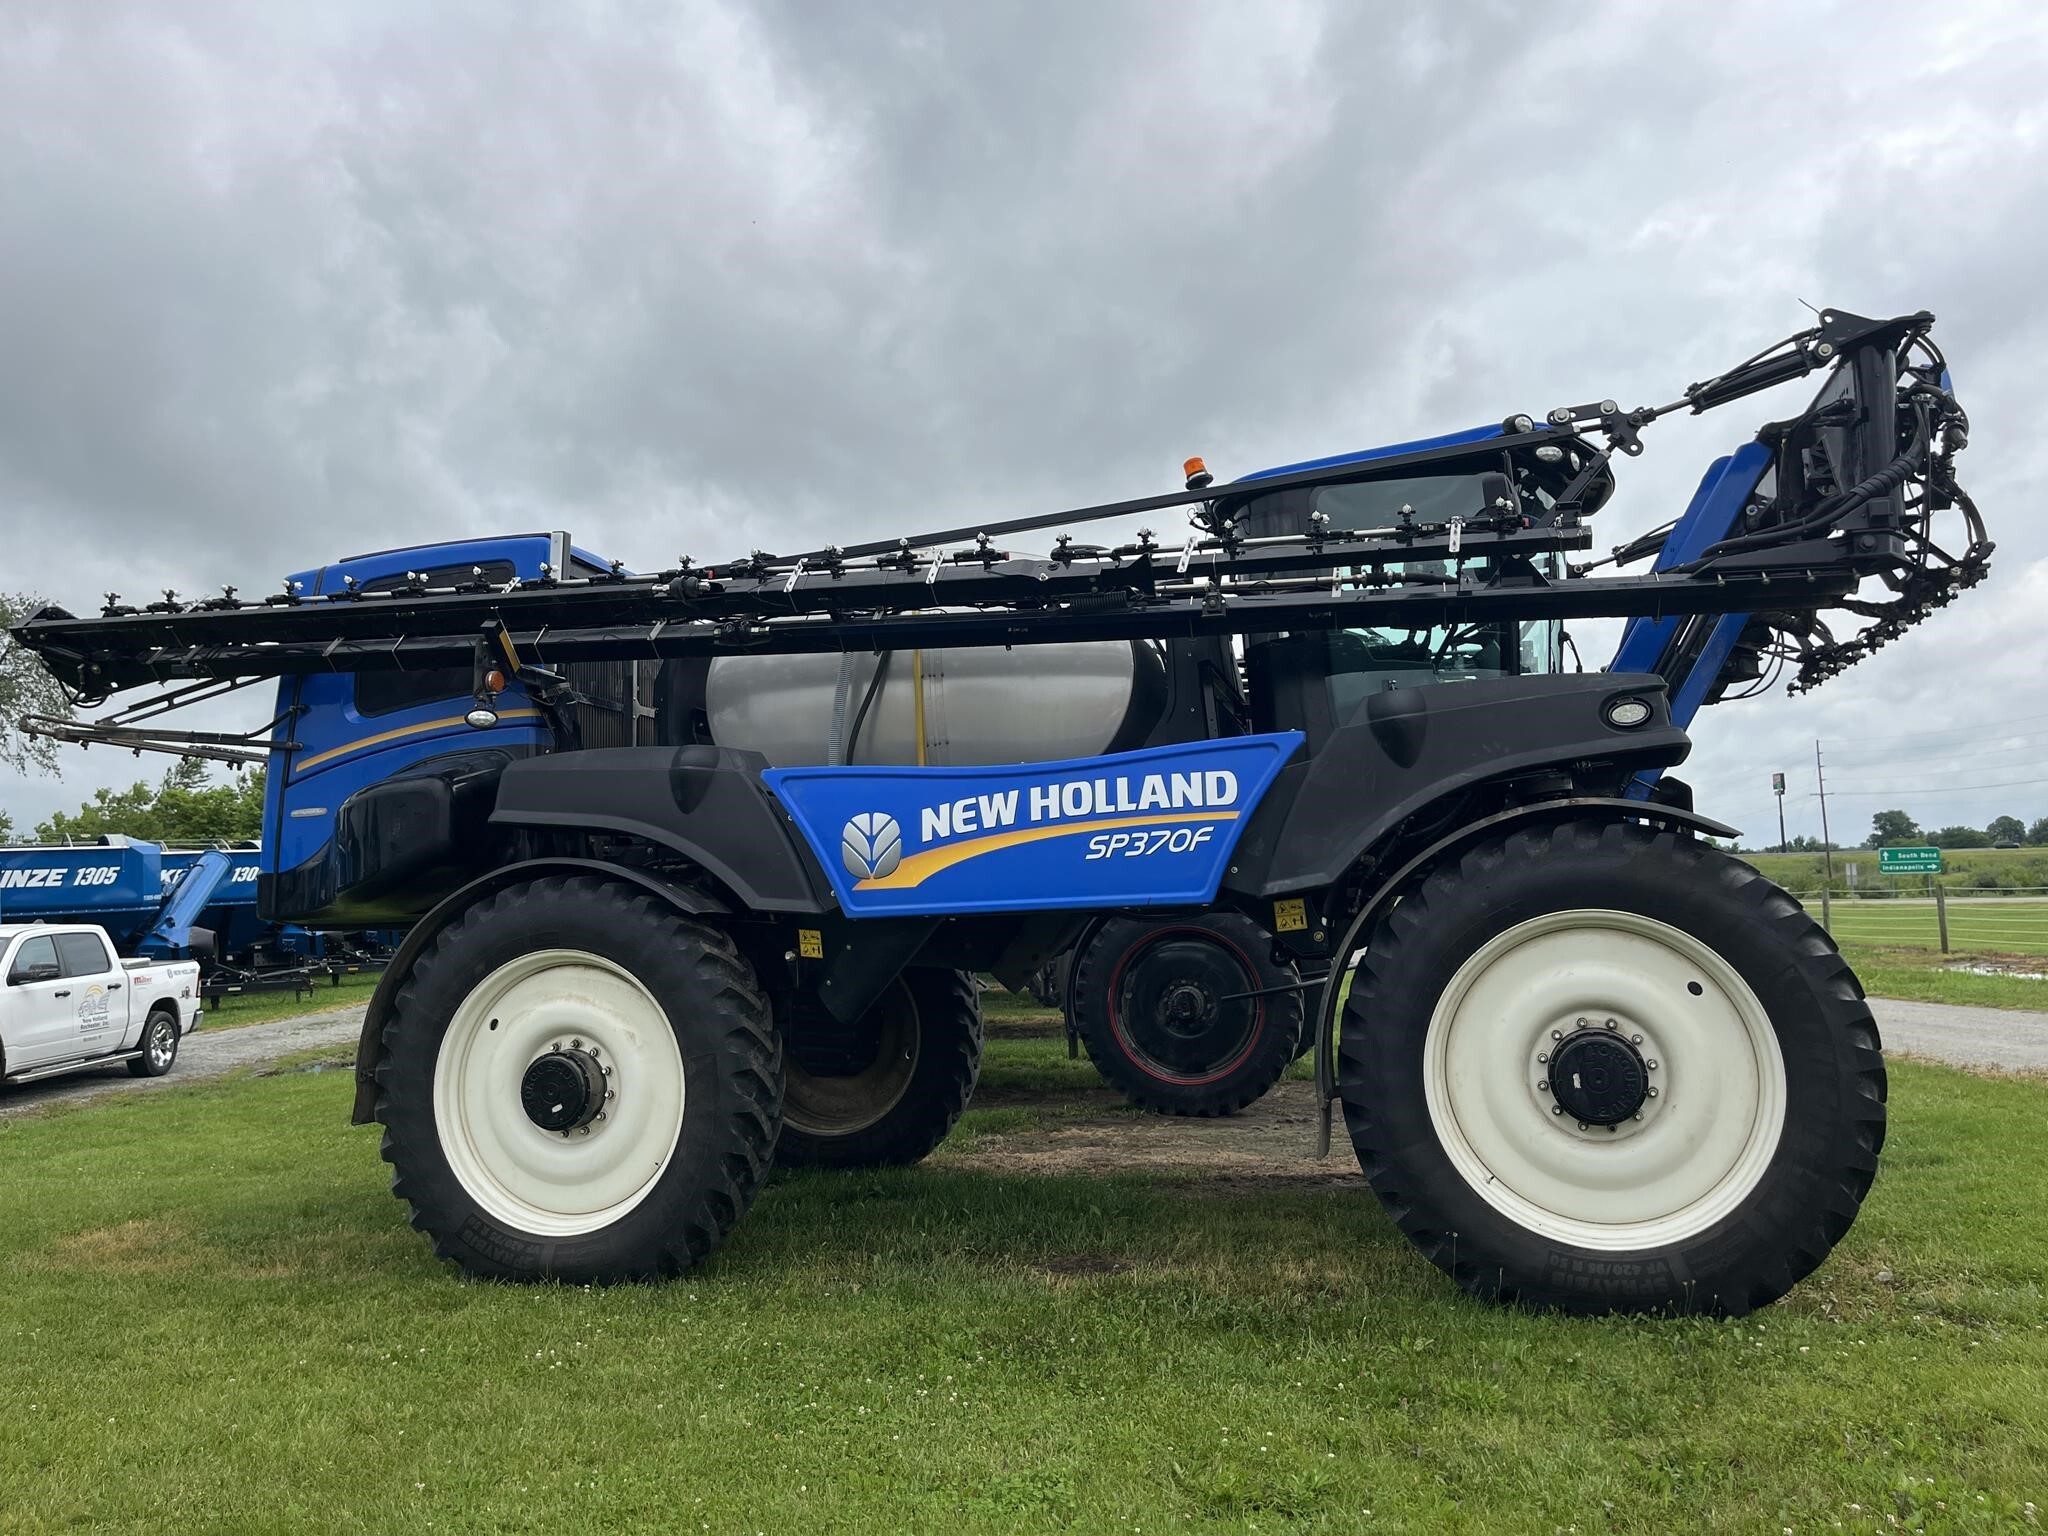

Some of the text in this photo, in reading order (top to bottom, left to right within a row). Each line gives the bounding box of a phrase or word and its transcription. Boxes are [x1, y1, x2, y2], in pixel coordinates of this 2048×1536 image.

[921, 770, 1238, 842] NEW HOLLAND
[1085, 826, 1215, 860] SP370F
[0, 866, 121, 889] INZE 1305
[231, 866, 260, 883] 130
